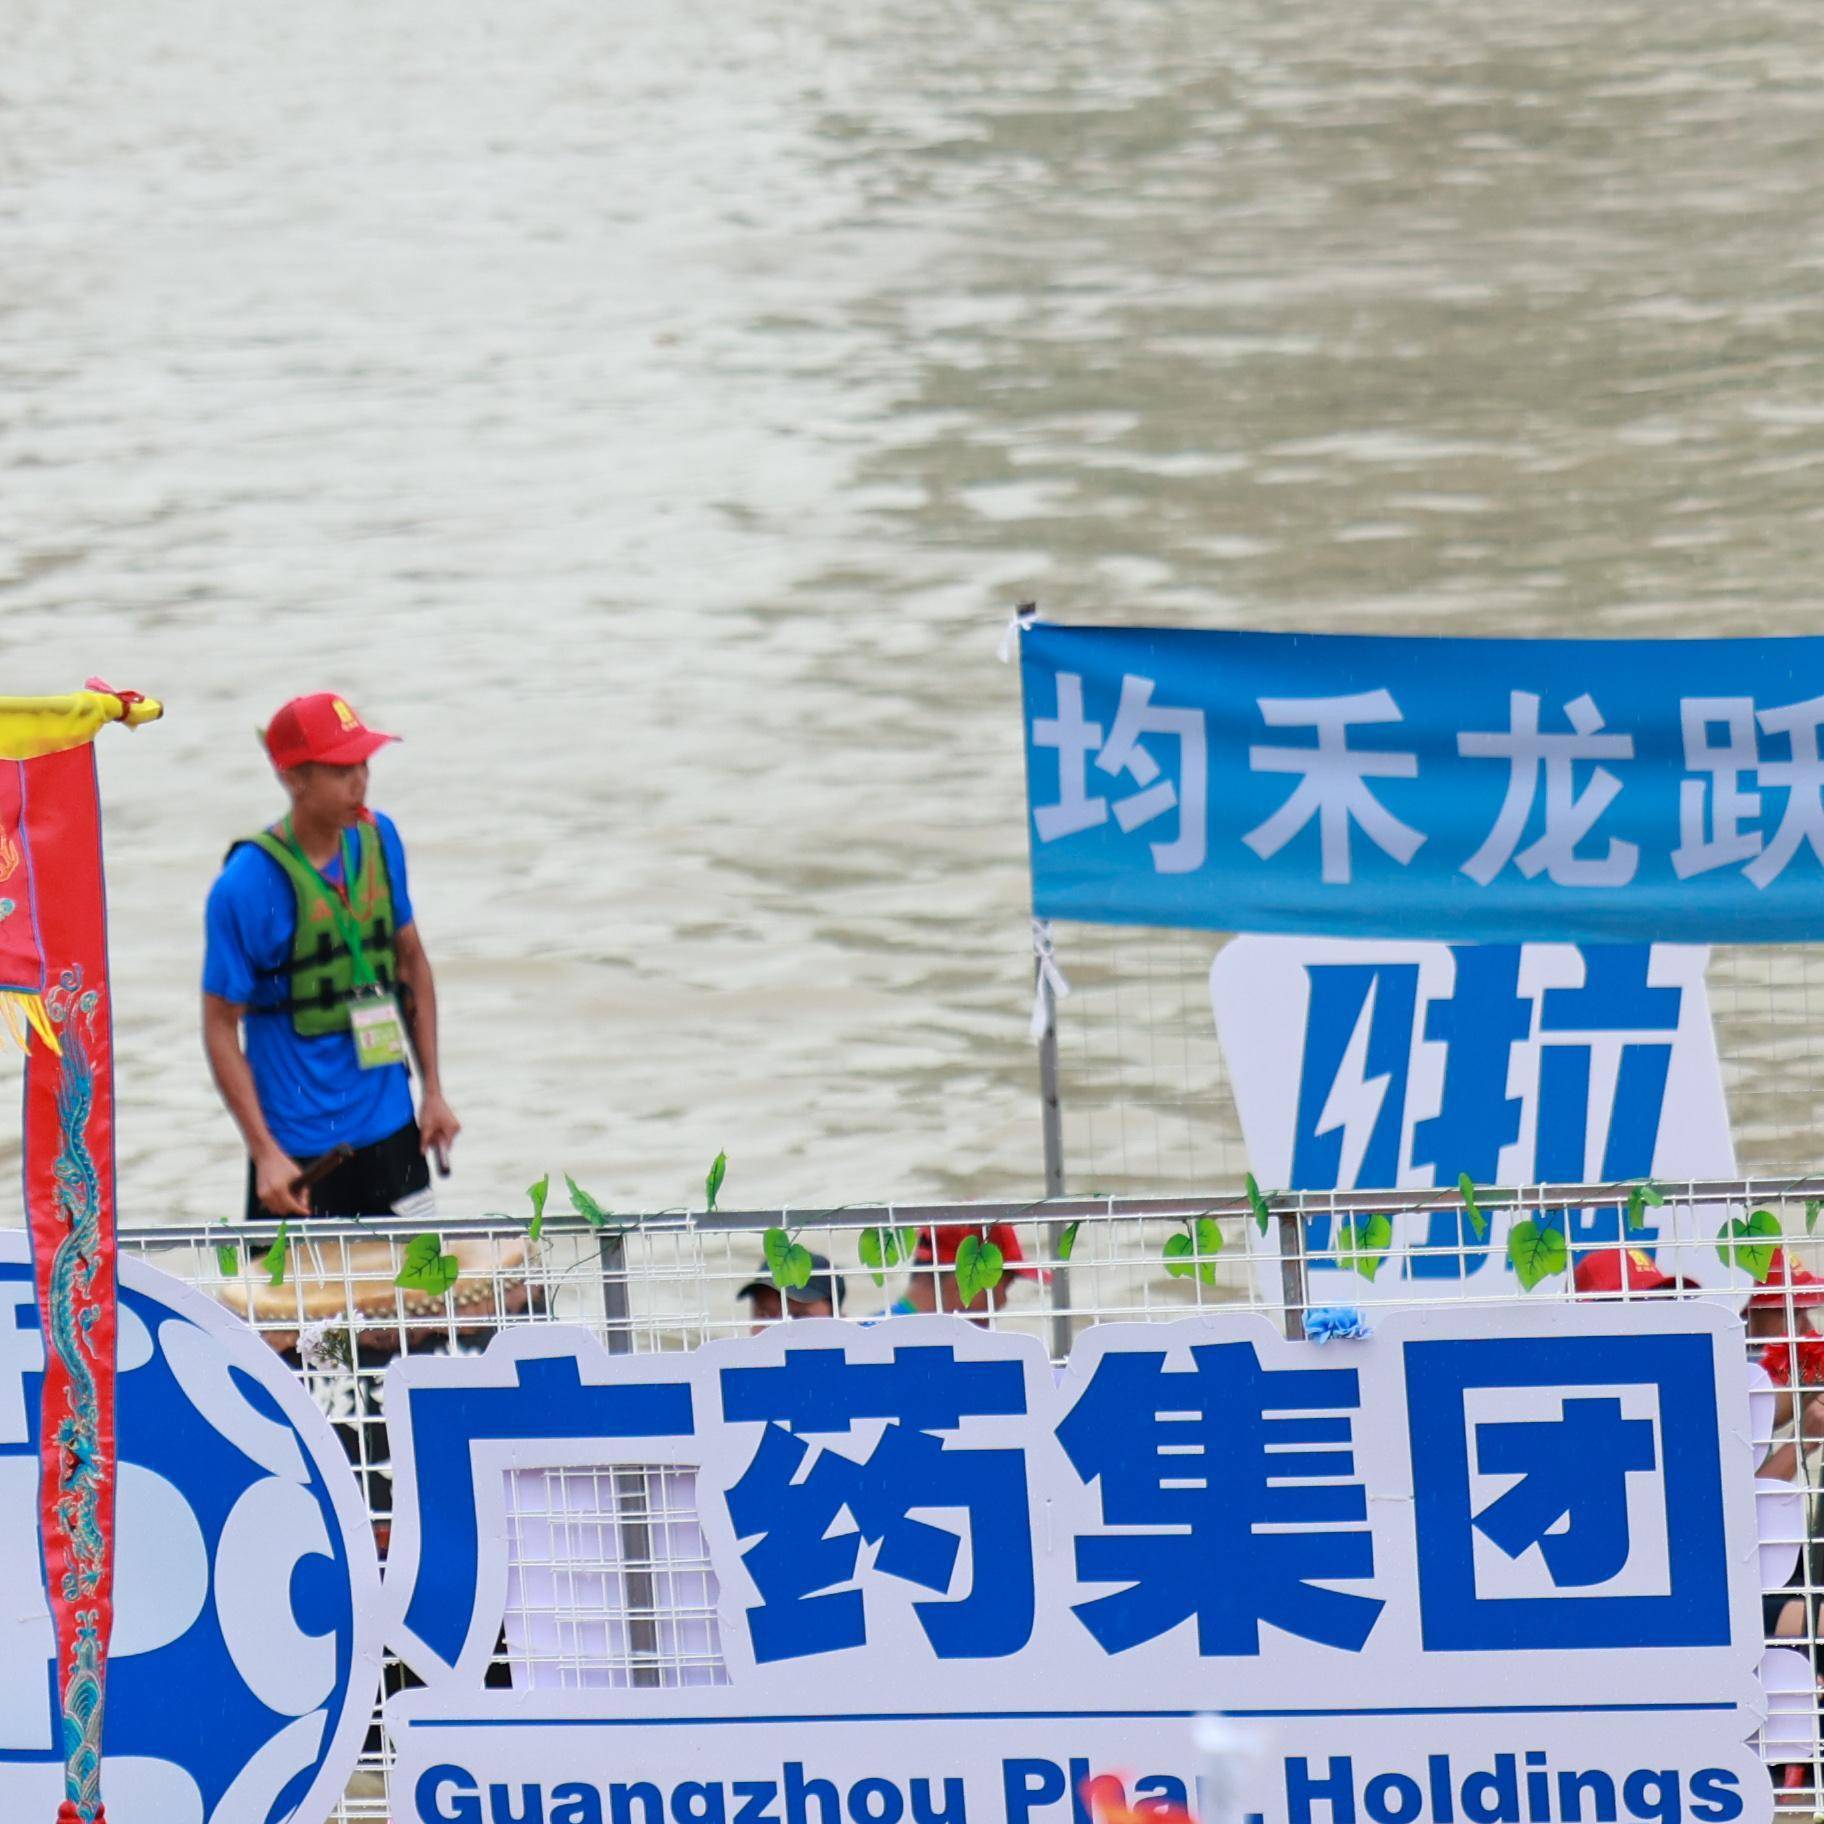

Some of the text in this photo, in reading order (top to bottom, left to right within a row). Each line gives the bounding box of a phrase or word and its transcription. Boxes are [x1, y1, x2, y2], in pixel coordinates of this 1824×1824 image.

[1032, 672, 1824, 889] 均禾龙跃
[402, 1333, 1732, 1670] 广药集团
